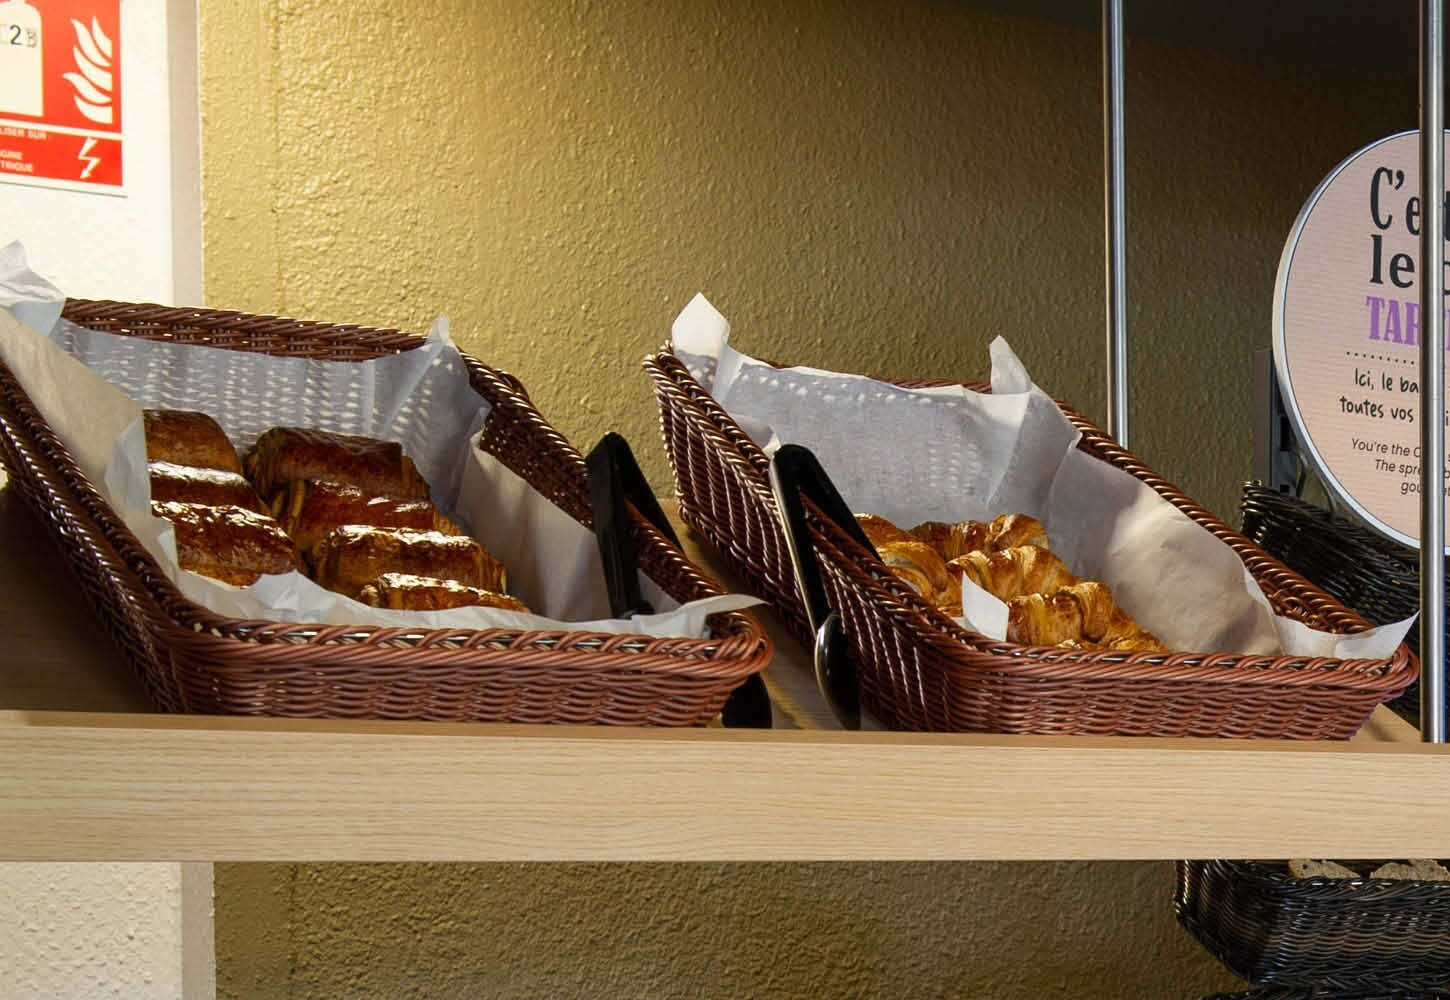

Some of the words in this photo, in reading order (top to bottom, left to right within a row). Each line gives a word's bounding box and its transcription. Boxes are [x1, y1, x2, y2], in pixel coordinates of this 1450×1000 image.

[1370, 234, 1415, 288] le
[1354, 368, 1375, 390] Ici,
[1382, 372, 1393, 391] le
[1400, 376, 1419, 394] ba
[1339, 396, 1384, 419] toutes
[1390, 407, 1414, 423] vos
[1351, 438, 1388, 454] You're
[1391, 444, 1410, 457] the
[1375, 459, 1396, 472] The
